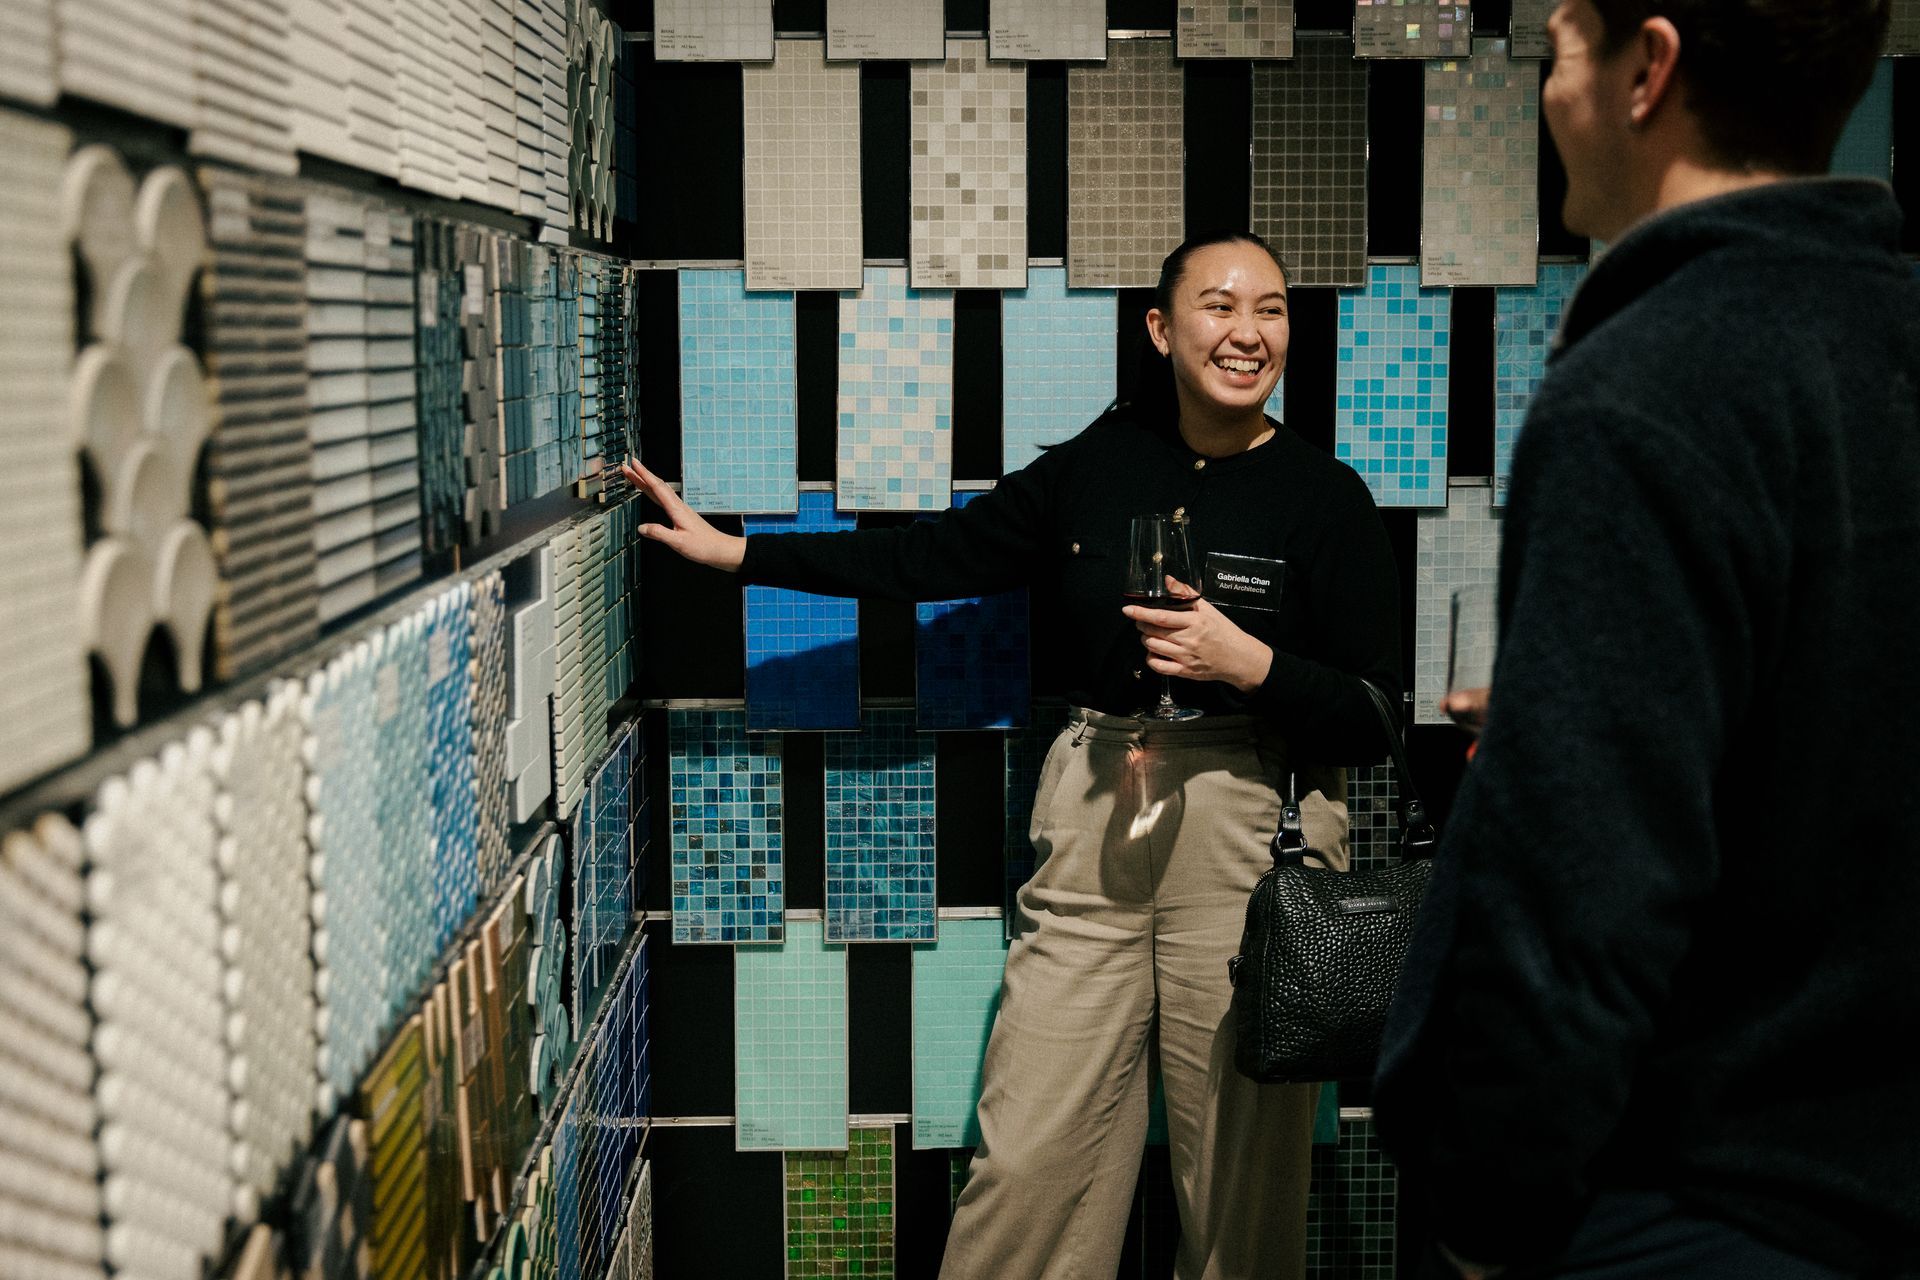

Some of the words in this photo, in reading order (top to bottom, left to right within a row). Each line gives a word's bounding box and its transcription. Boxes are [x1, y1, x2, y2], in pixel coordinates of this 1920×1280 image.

[1217, 573, 1249, 583] Gabriella
[1251, 577, 1270, 586] Chan
[1233, 584, 1265, 593] Architects
